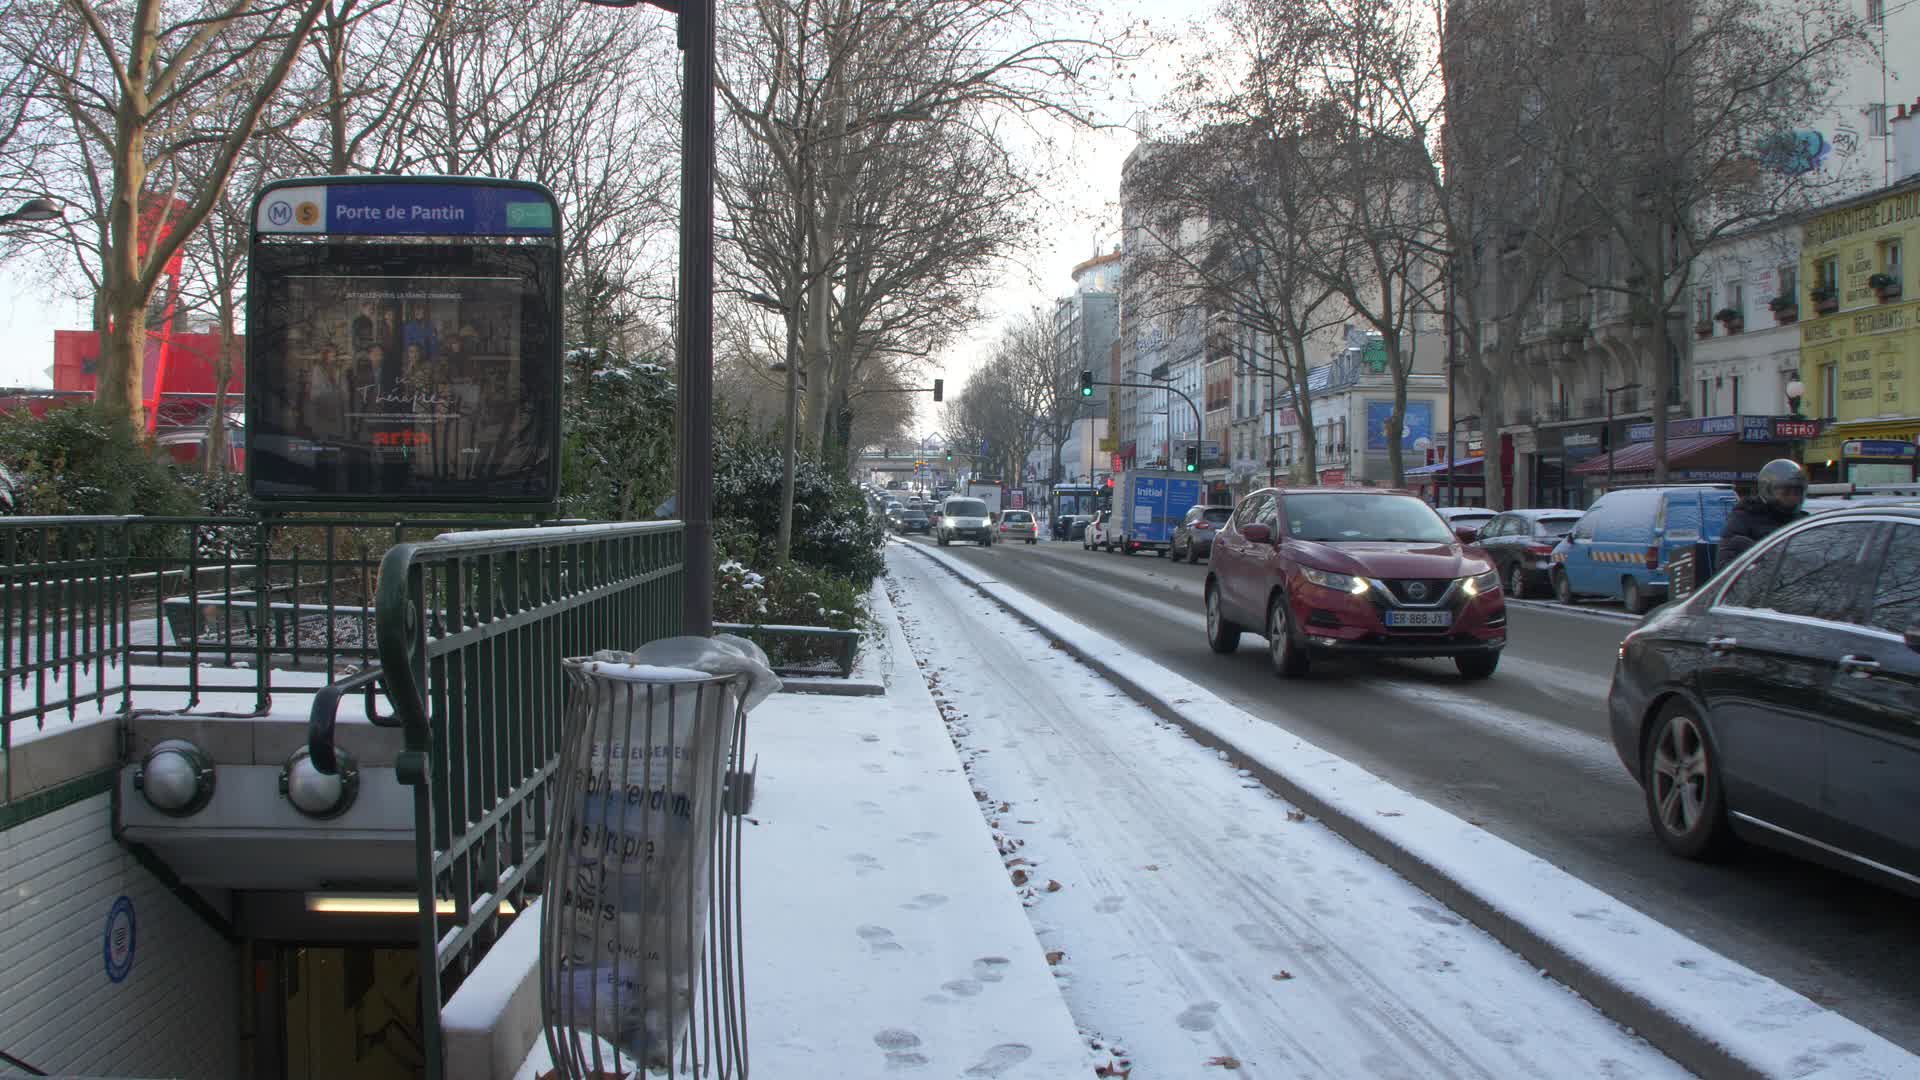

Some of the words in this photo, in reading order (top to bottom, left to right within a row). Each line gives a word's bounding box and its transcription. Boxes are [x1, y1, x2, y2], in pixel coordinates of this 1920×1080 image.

[336, 204, 381, 220] Porte
[385, 203, 406, 220] de
[411, 204, 465, 220] Pantin
[1137, 487, 1163, 497] Initial
